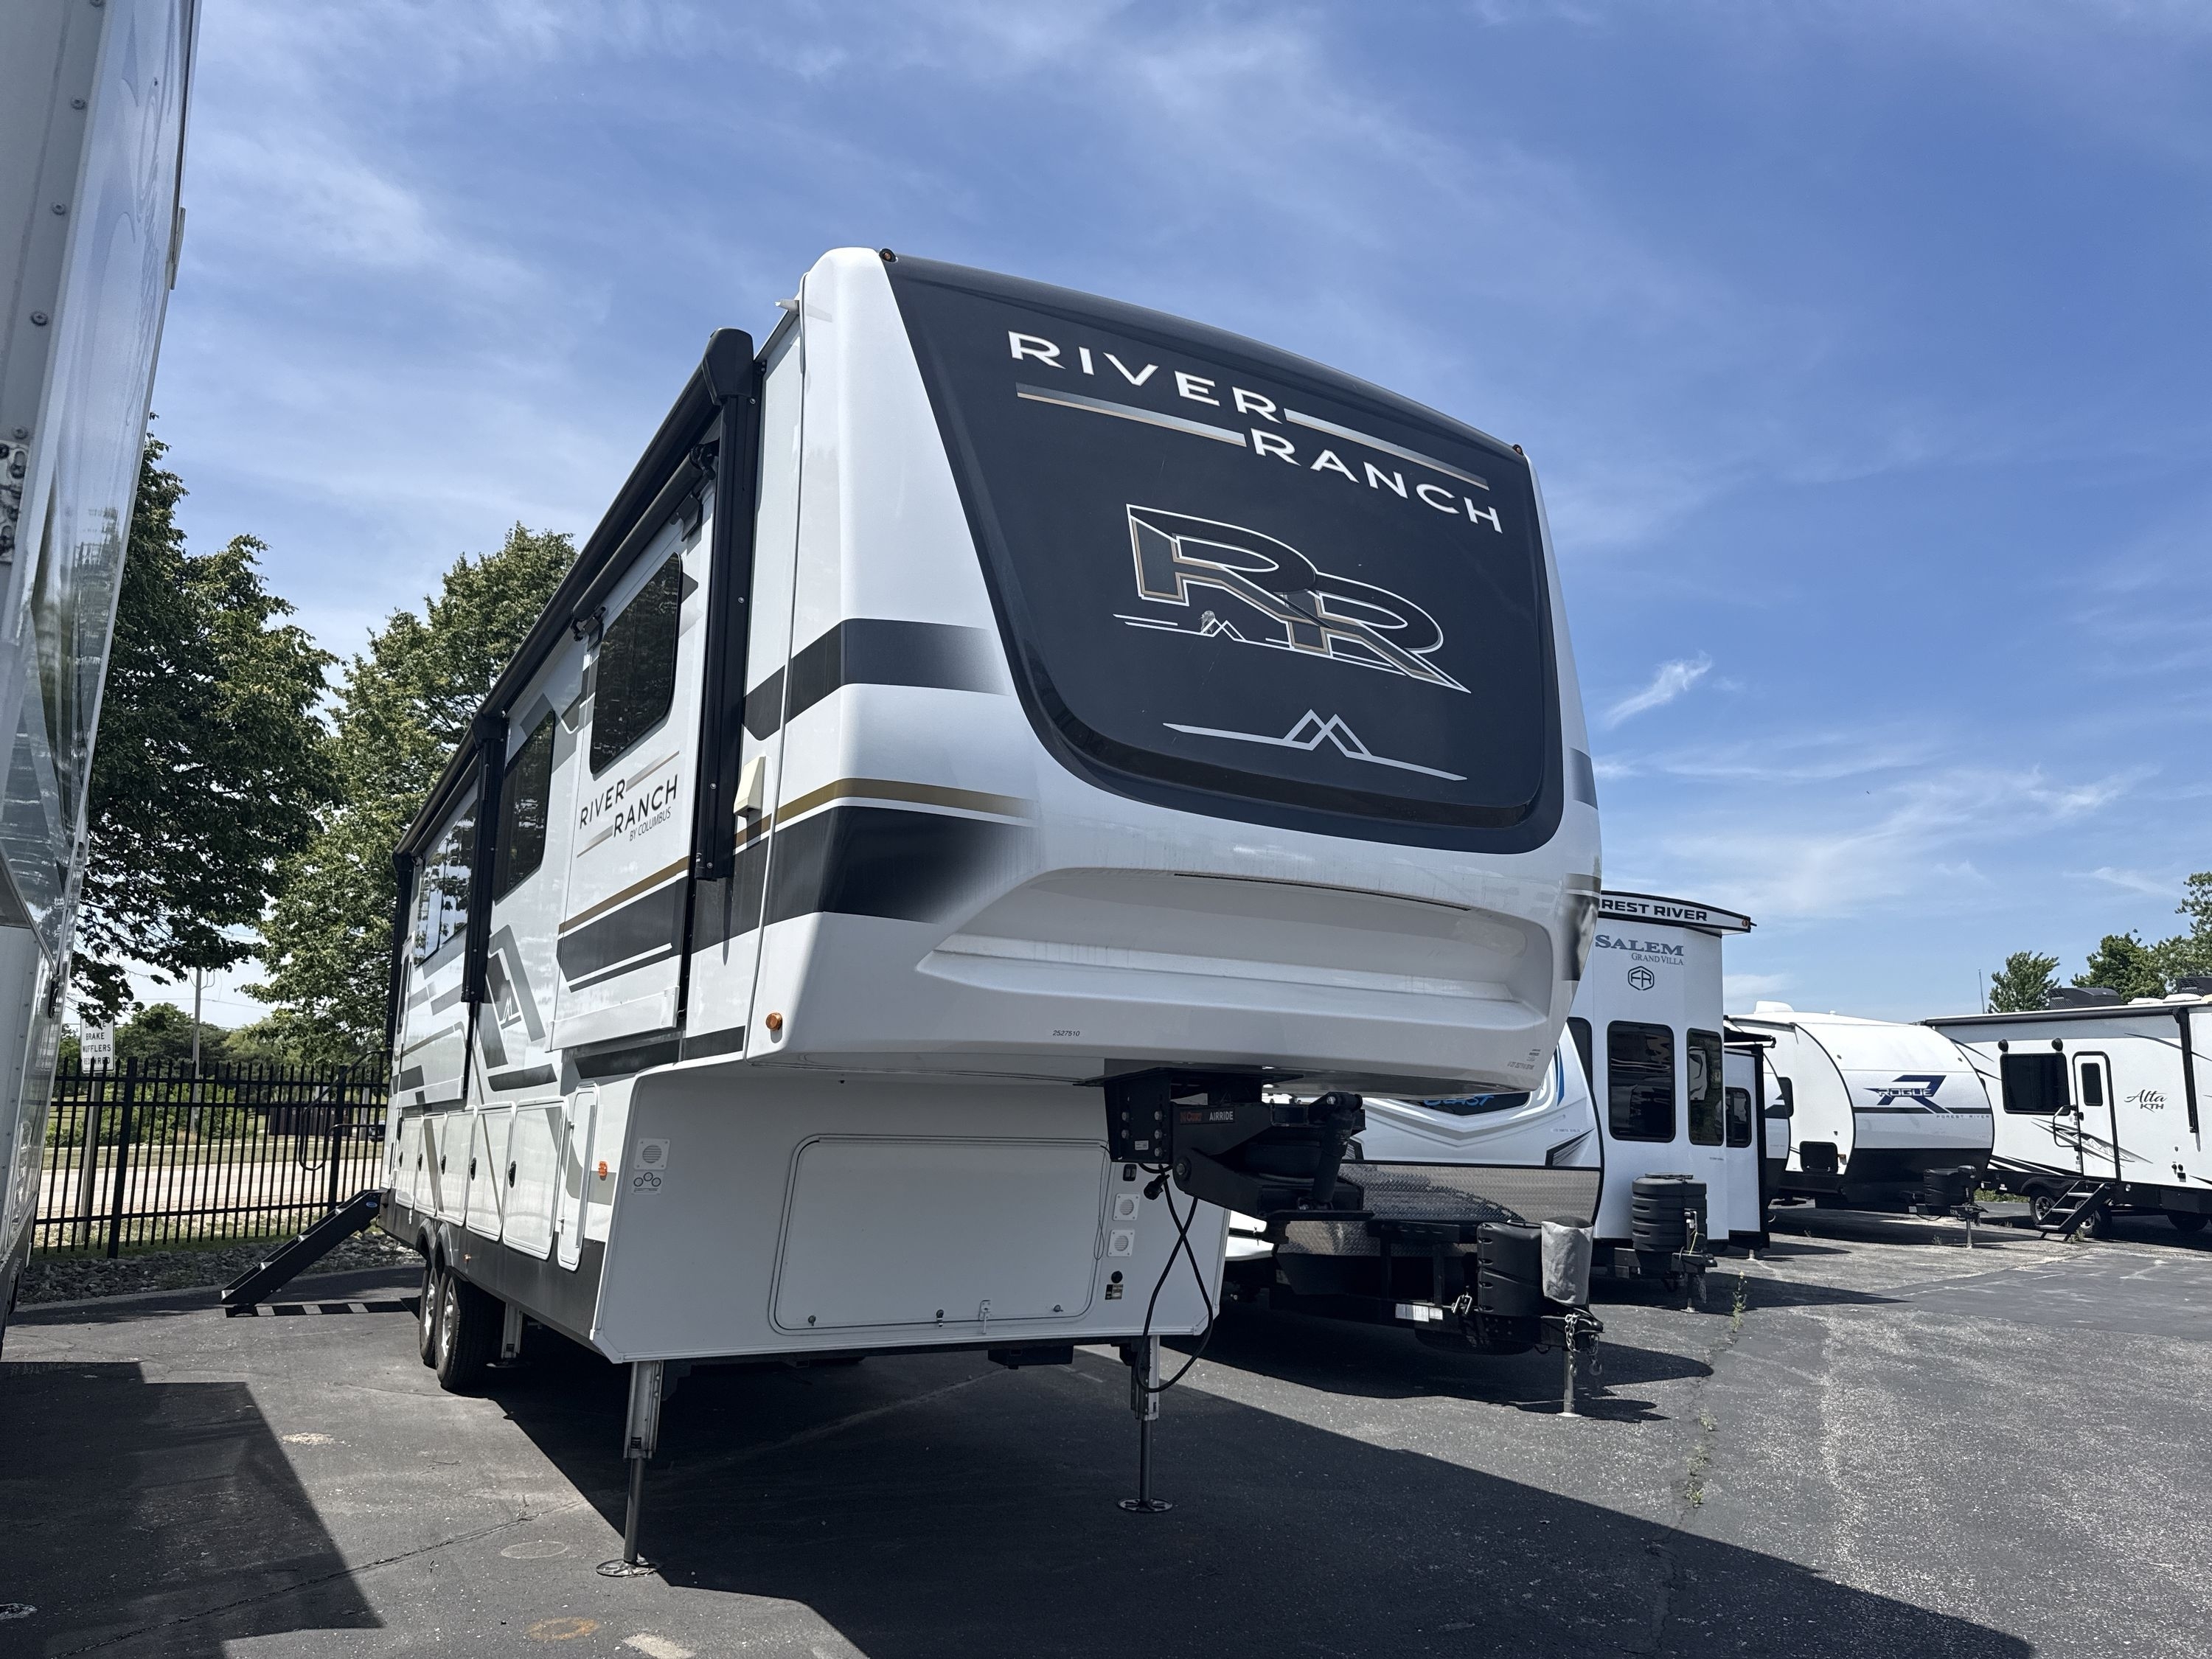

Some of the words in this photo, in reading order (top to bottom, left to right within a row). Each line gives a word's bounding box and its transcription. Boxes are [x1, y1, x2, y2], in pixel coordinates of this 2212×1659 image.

[1007, 330, 1283, 424] RIVER
[1250, 428, 1503, 534] RANCH
[580, 778, 626, 830] RIVER
[613, 773, 678, 838] RANCH
[630, 826, 638, 842] BY
[638, 806, 672, 836] COLUMBUS
[1599, 899, 1649, 914] REST
[1654, 905, 1708, 922] RIVER
[1595, 934, 1684, 956] SALEM
[1631, 952, 1660, 963] GRAND
[1660, 956, 1684, 966] VILLA
[86, 1032, 105, 1040] BRAKE
[1878, 1088, 1933, 1099] ROGUE
[2124, 1089, 2168, 1104] Alta
[1209, 1110, 1234, 1121] AIRRIDE
[2140, 1103, 2165, 1113] KTH
